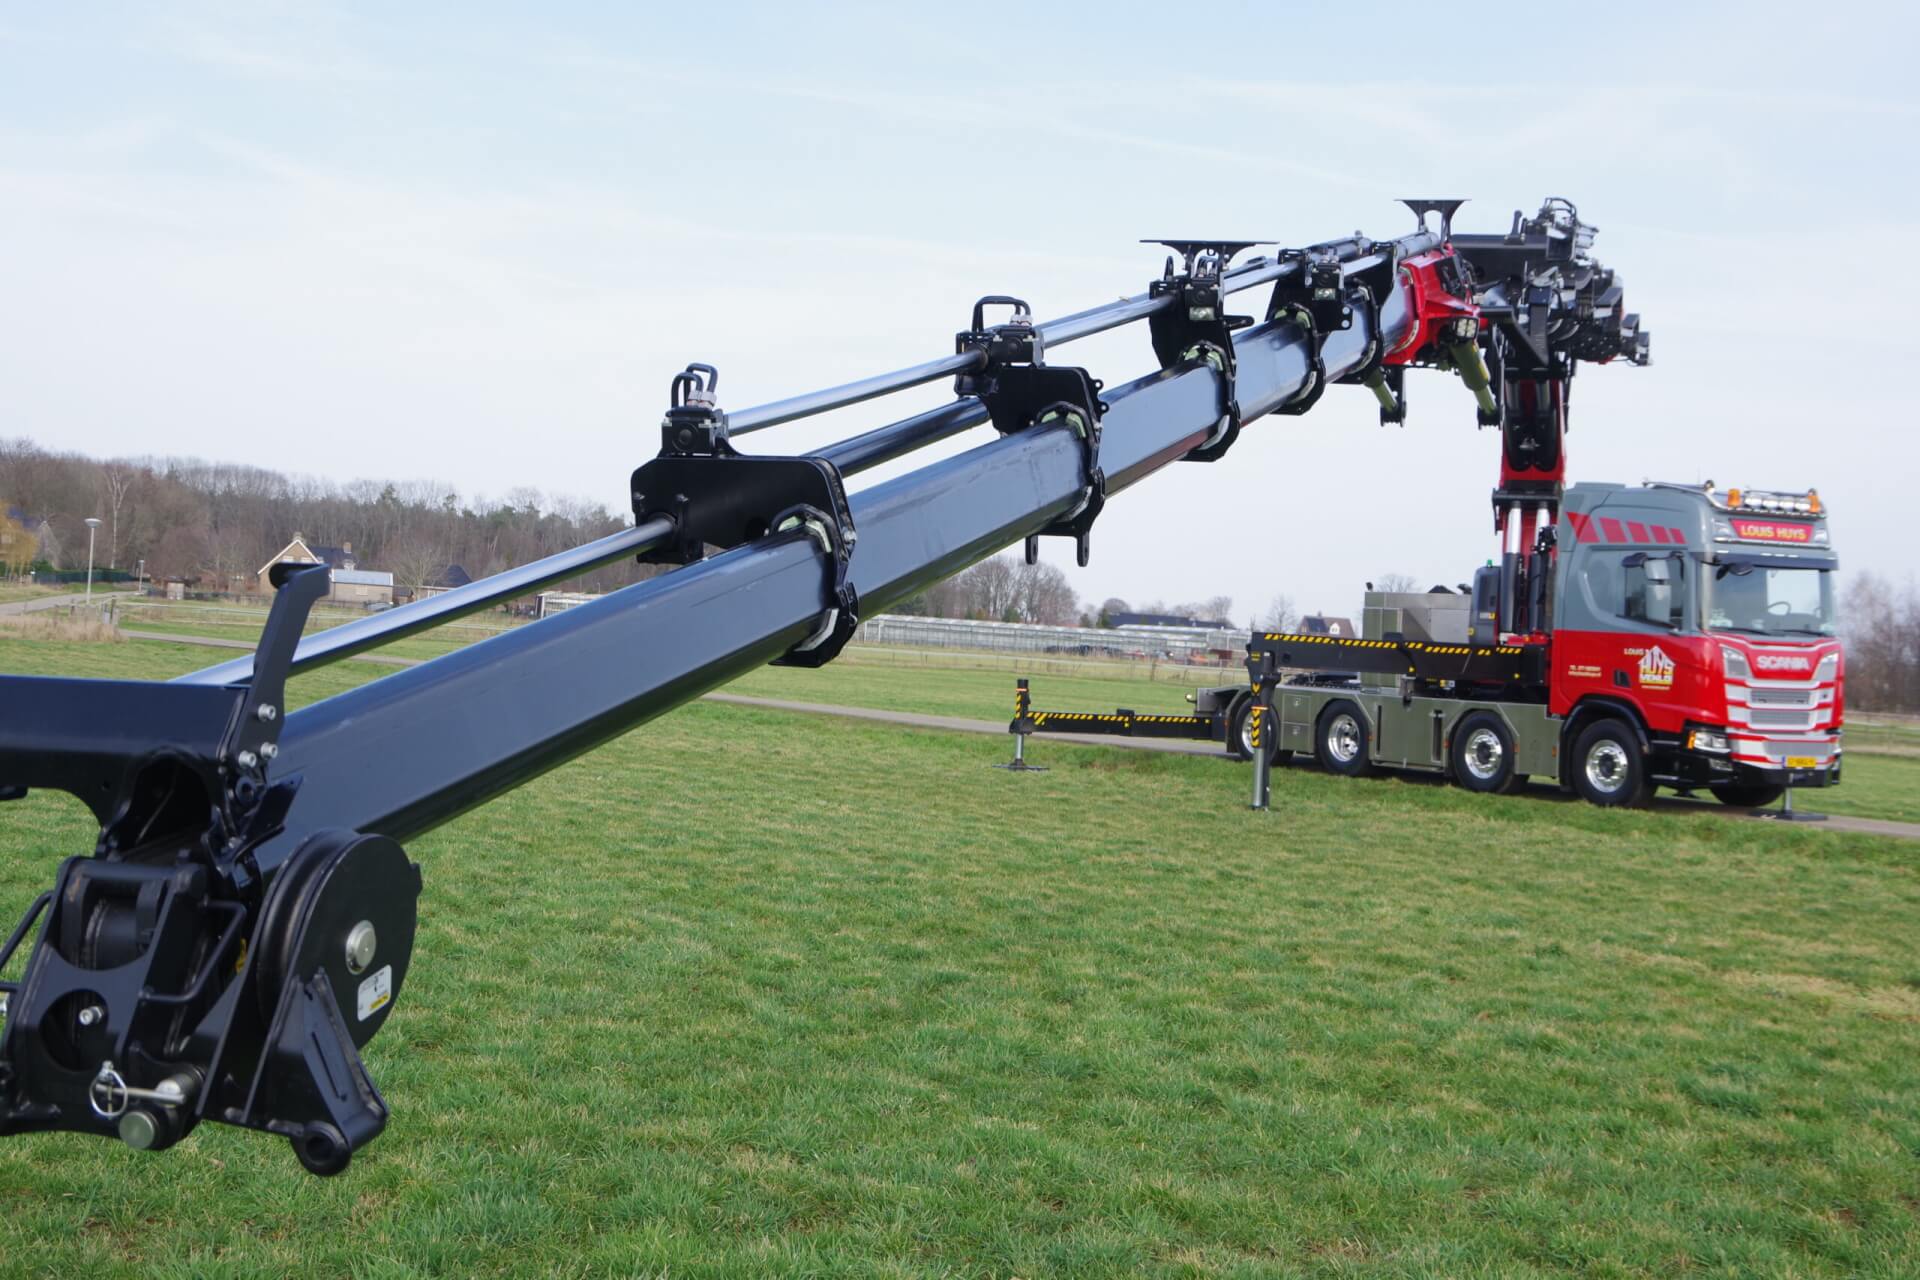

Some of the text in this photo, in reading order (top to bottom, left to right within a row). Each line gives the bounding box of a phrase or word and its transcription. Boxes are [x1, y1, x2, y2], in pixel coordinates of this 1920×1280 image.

[1740, 524, 1808, 540] LOUIS HUYS
[1623, 647, 1645, 656] LOUIS
[1639, 648, 1674, 675] HUYS
[1756, 655, 1810, 670] SCANIA
